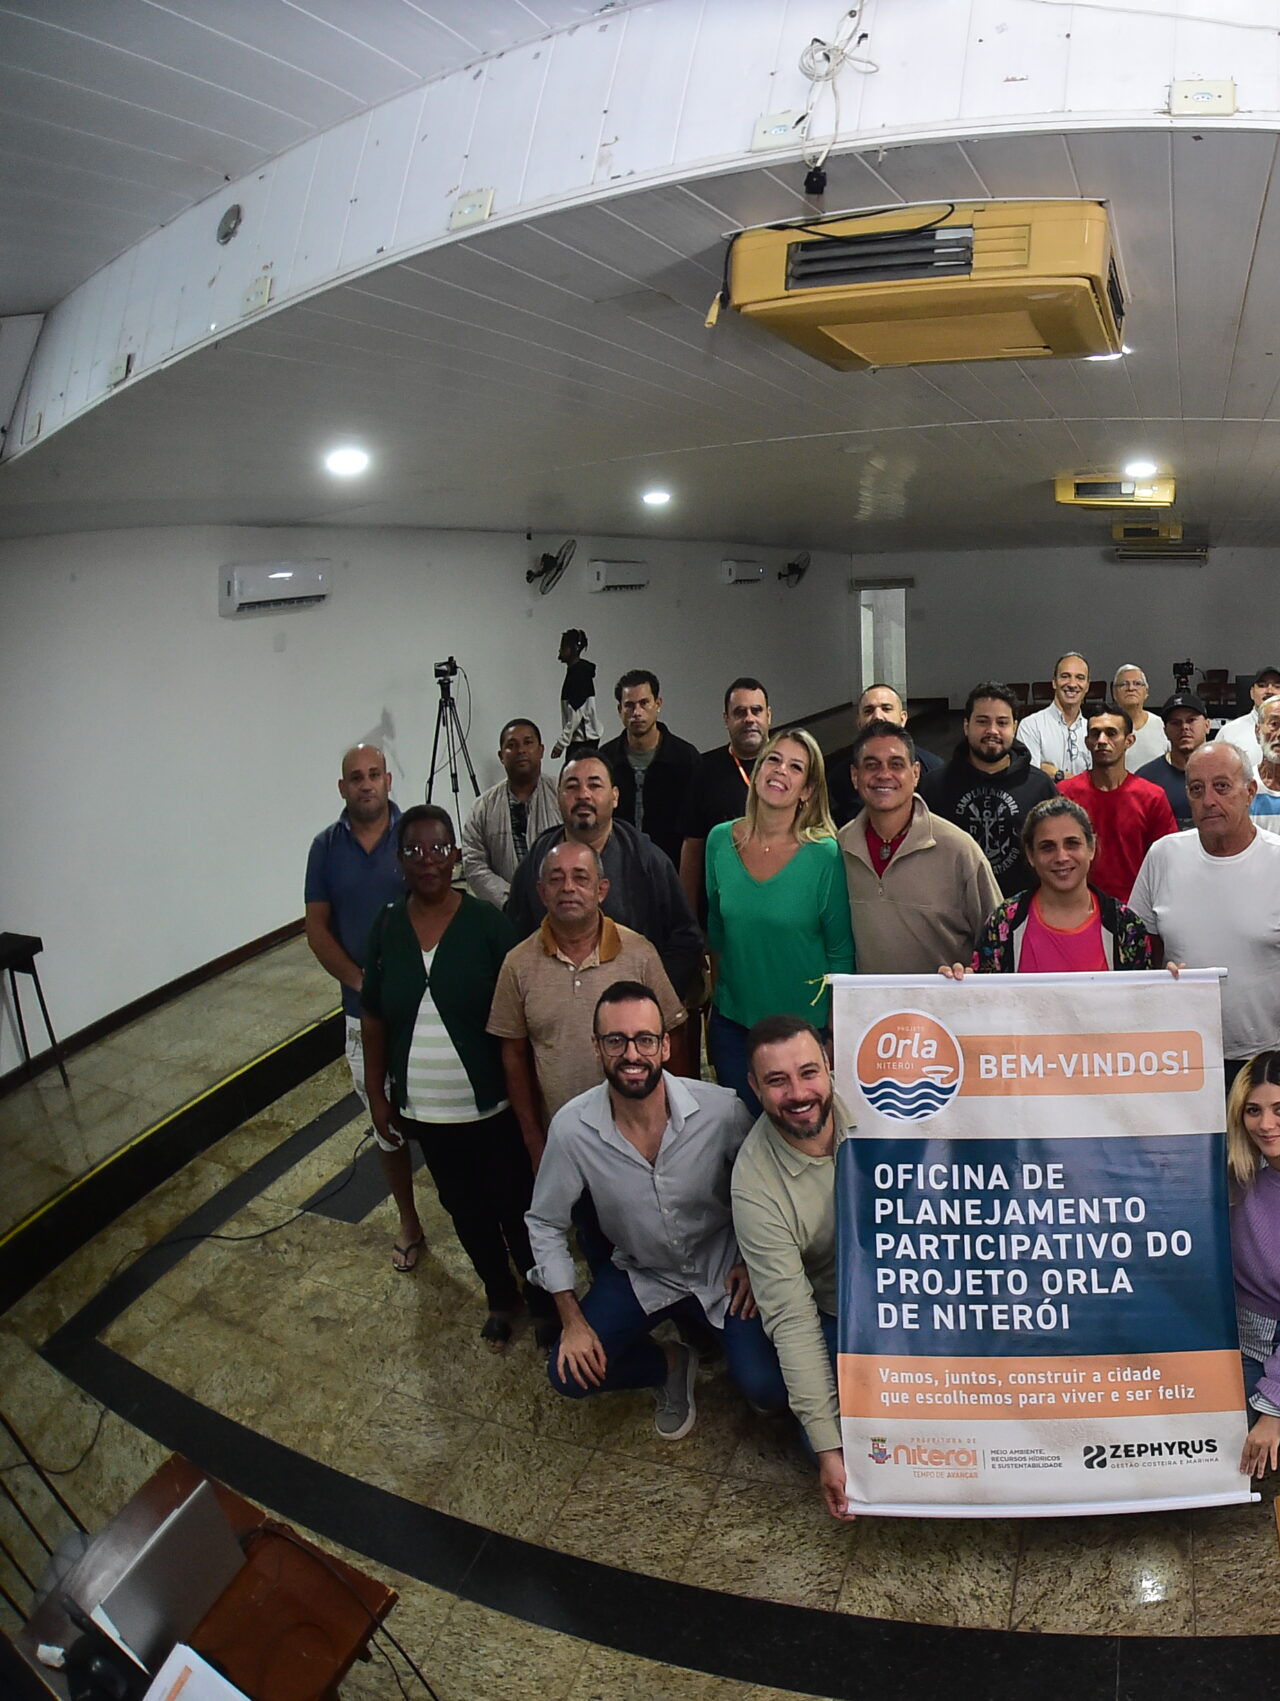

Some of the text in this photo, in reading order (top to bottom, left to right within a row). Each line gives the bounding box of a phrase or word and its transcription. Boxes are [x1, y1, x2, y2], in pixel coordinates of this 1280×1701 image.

[877, 1033, 938, 1059] Orla
[876, 1061, 915, 1070] NITERÓI
[979, 1050, 1189, 1079] BEM-VINDOS!
[874, 1163, 1065, 1190] OFICINA DE
[875, 1197, 1146, 1225] PLANEJAMENTO
[876, 1230, 1193, 1260] PARTICIPATIVO DO
[877, 1267, 1134, 1296] PROJETO ORLA
[878, 1298, 1070, 1330] DE NITERÓI
[879, 1366, 1161, 1388] Vamos, juntos, construir a cidade
[880, 1384, 1195, 1408] que escolhemos para viver e ser feliz
[1109, 1439, 1218, 1458] ZEPHYRUS
[1110, 1461, 1140, 1469] GESTÃO
